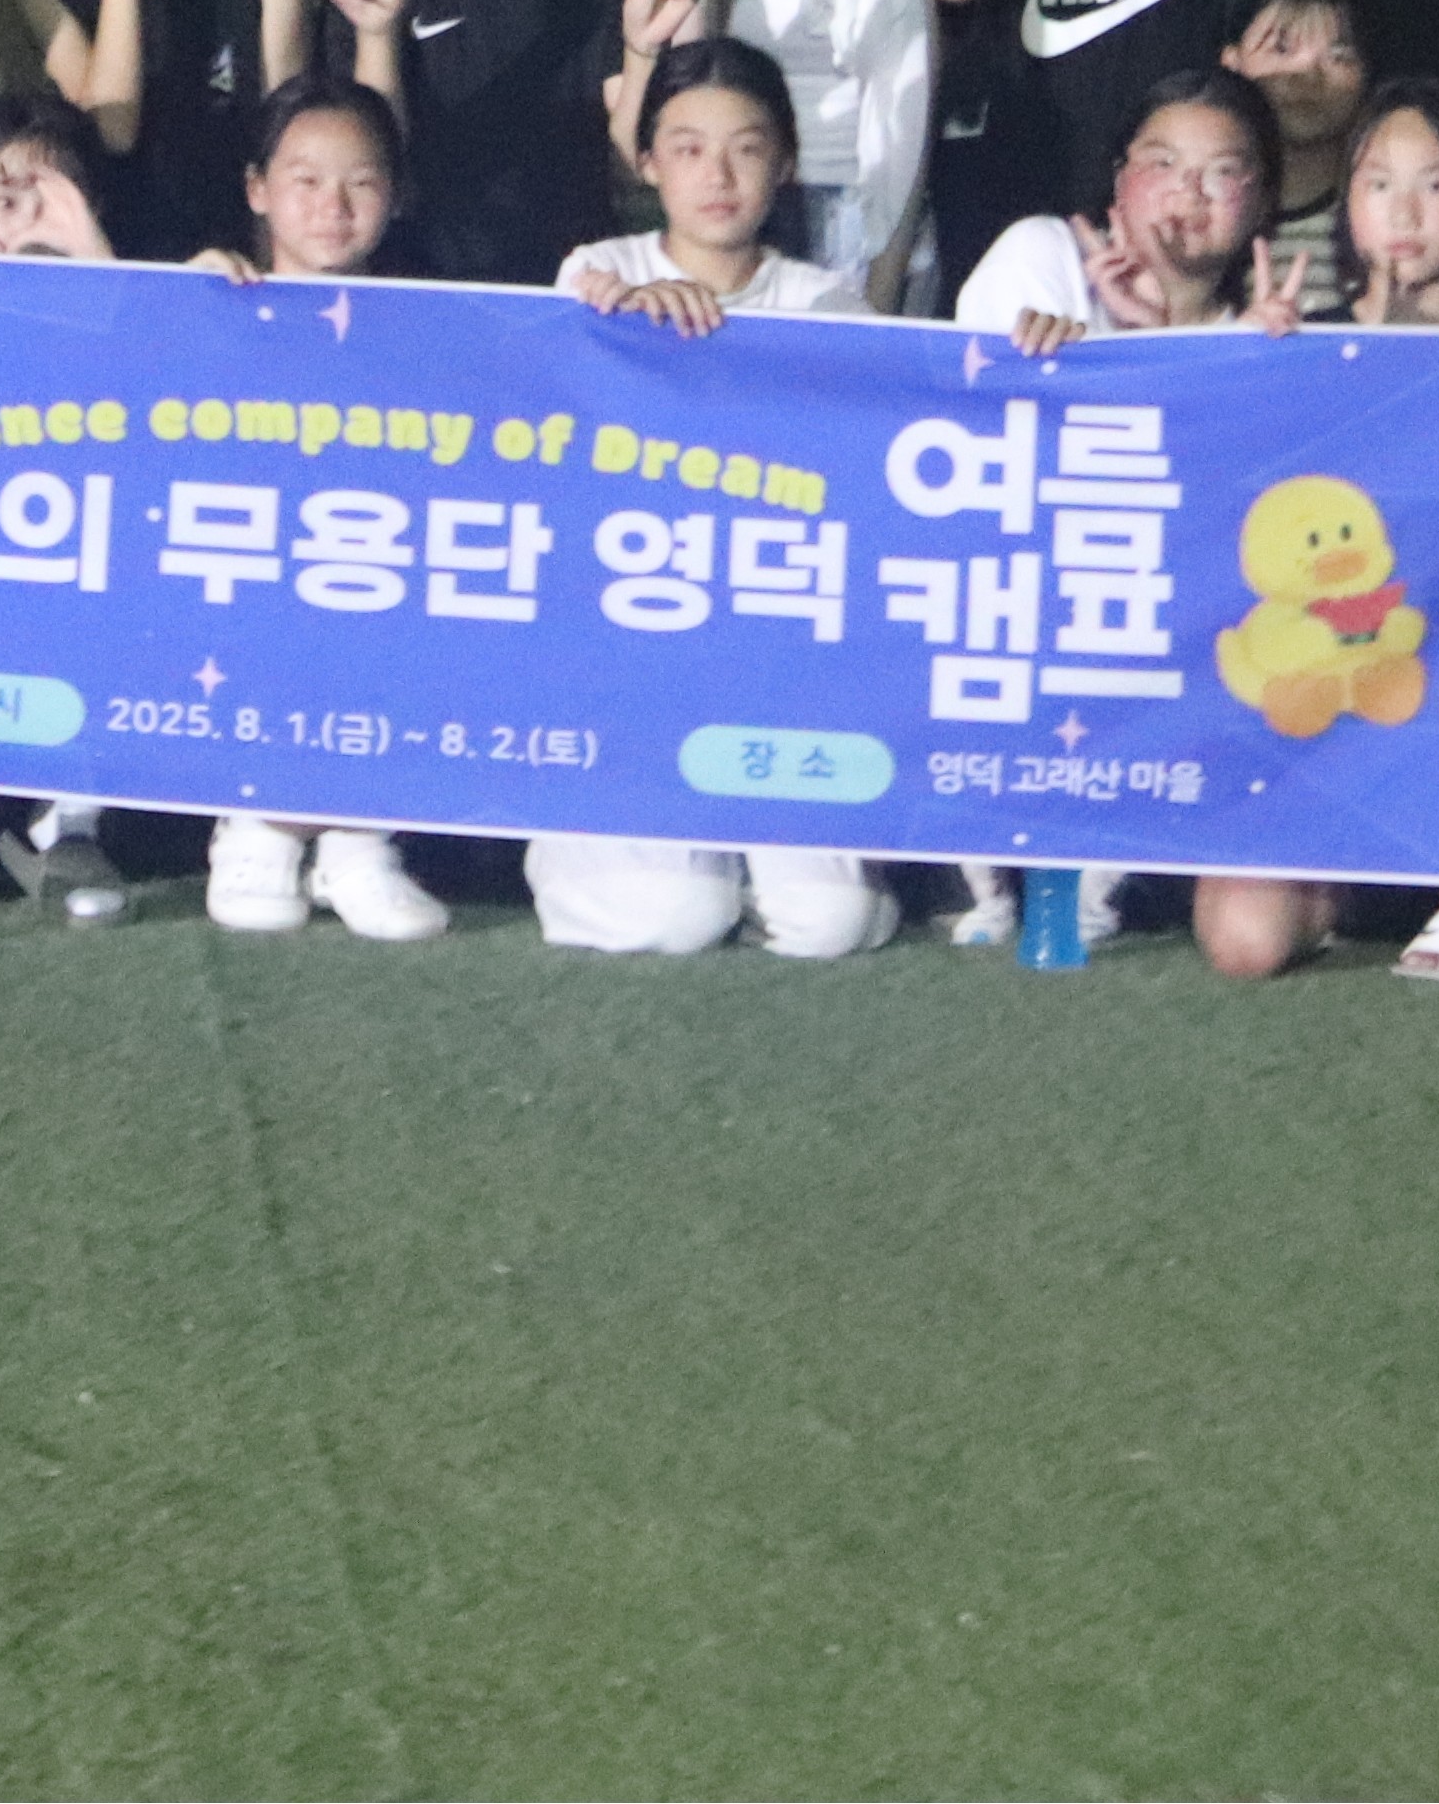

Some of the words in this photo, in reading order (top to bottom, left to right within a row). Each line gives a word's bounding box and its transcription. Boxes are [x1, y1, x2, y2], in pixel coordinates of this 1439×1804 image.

[149, 400, 474, 466] company
[493, 413, 575, 465] of
[592, 425, 826, 516] Dream
[884, 398, 1184, 572] 여름
[158, 480, 554, 623] 무용단
[593, 509, 848, 643] 영덕
[876, 551, 1185, 724] 캠프
[105, 698, 222, 741] 2025.
[233, 706, 271, 744] 8.
[438, 721, 478, 759] 8.
[927, 751, 1003, 796] 영덕
[1009, 755, 1123, 802] 고래산
[1128, 760, 1206, 805] 마을
